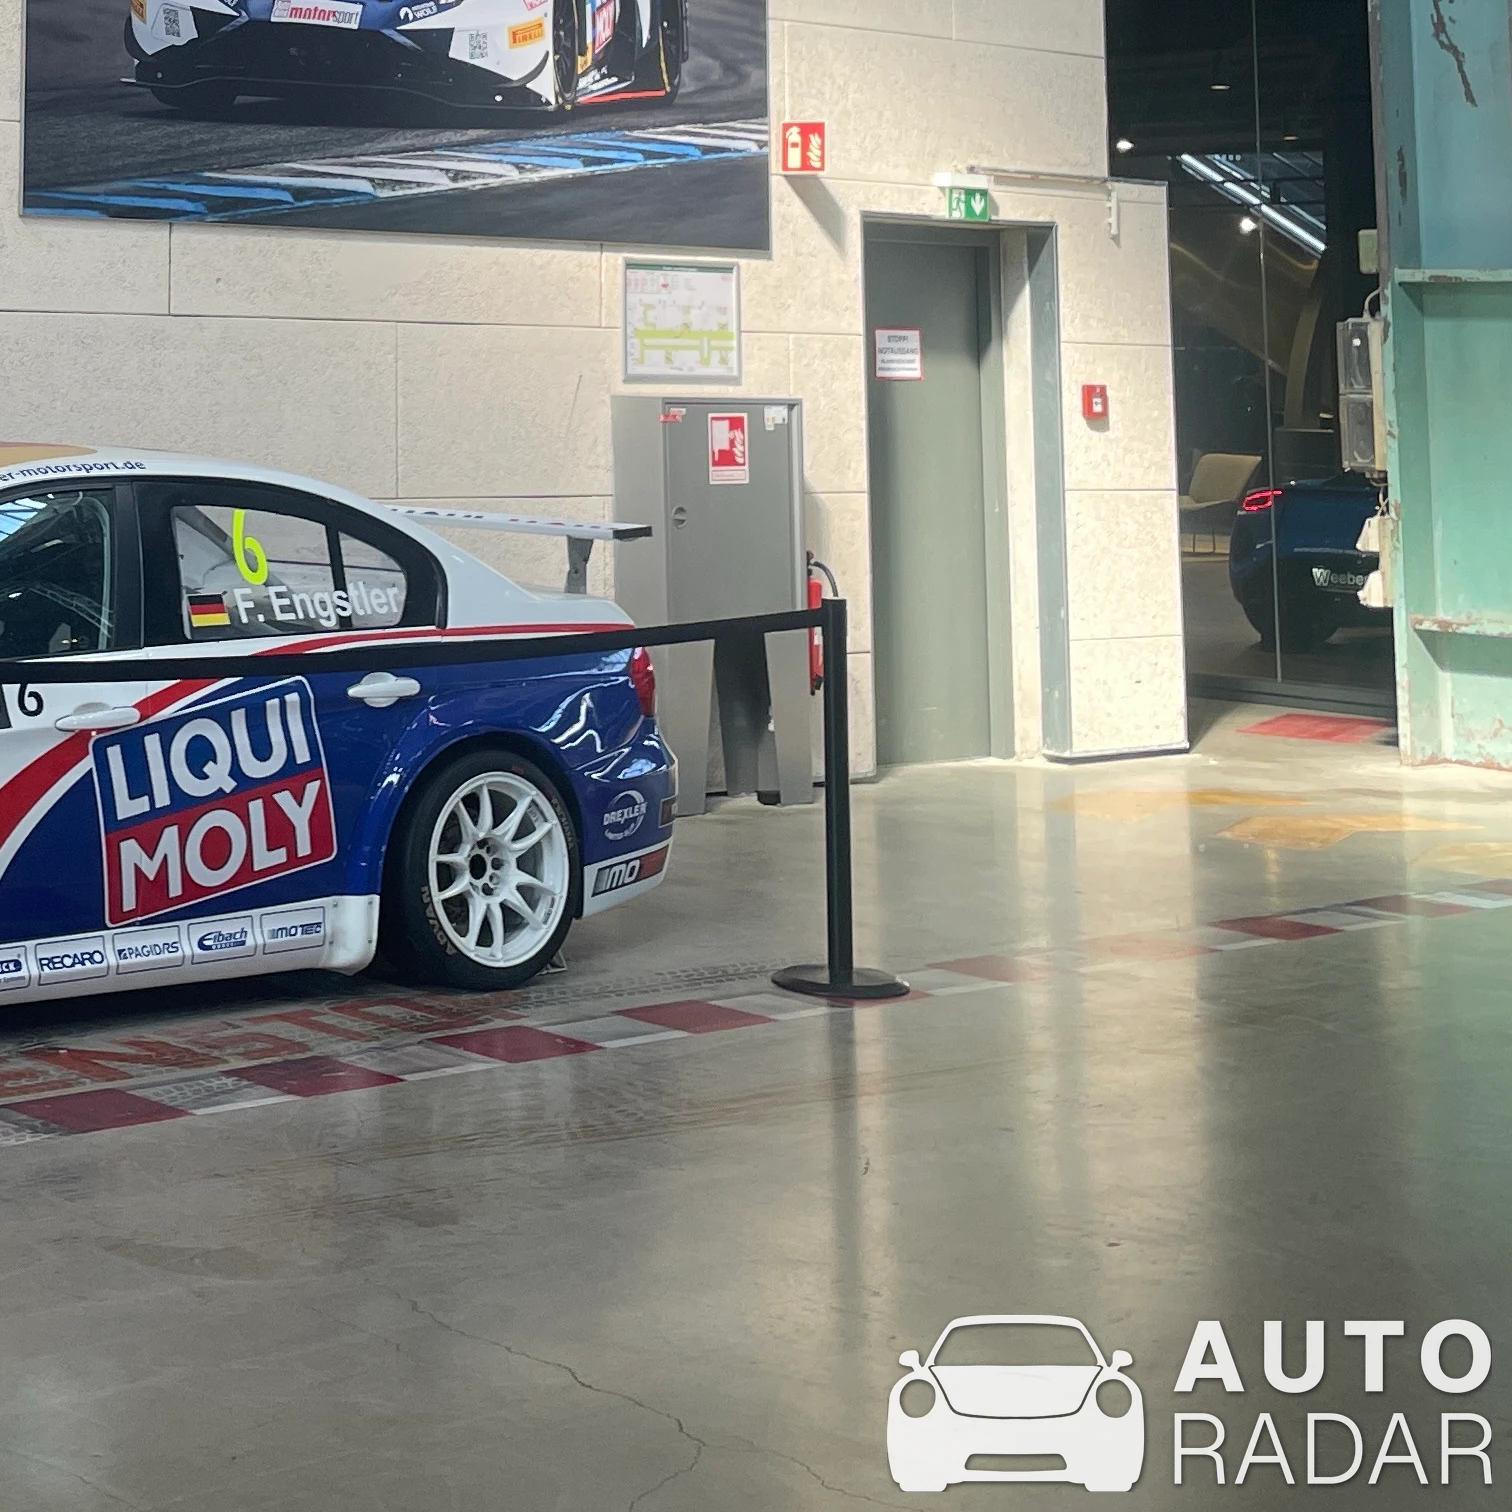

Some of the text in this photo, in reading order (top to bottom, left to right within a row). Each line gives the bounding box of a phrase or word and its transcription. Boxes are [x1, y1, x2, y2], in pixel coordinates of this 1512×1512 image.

[290, 6, 360, 25] motorsport
[512, 23, 544, 44] PIRELLI
[232, 508, 268, 585] 6
[233, 581, 400, 628] F. Engstler
[17, 683, 44, 717] 6
[106, 691, 311, 819] LIQUI
[603, 802, 648, 826] DREXLER
[119, 778, 322, 913] MOLY
[197, 928, 248, 951] Eibach
[39, 950, 105, 972] RECARO
